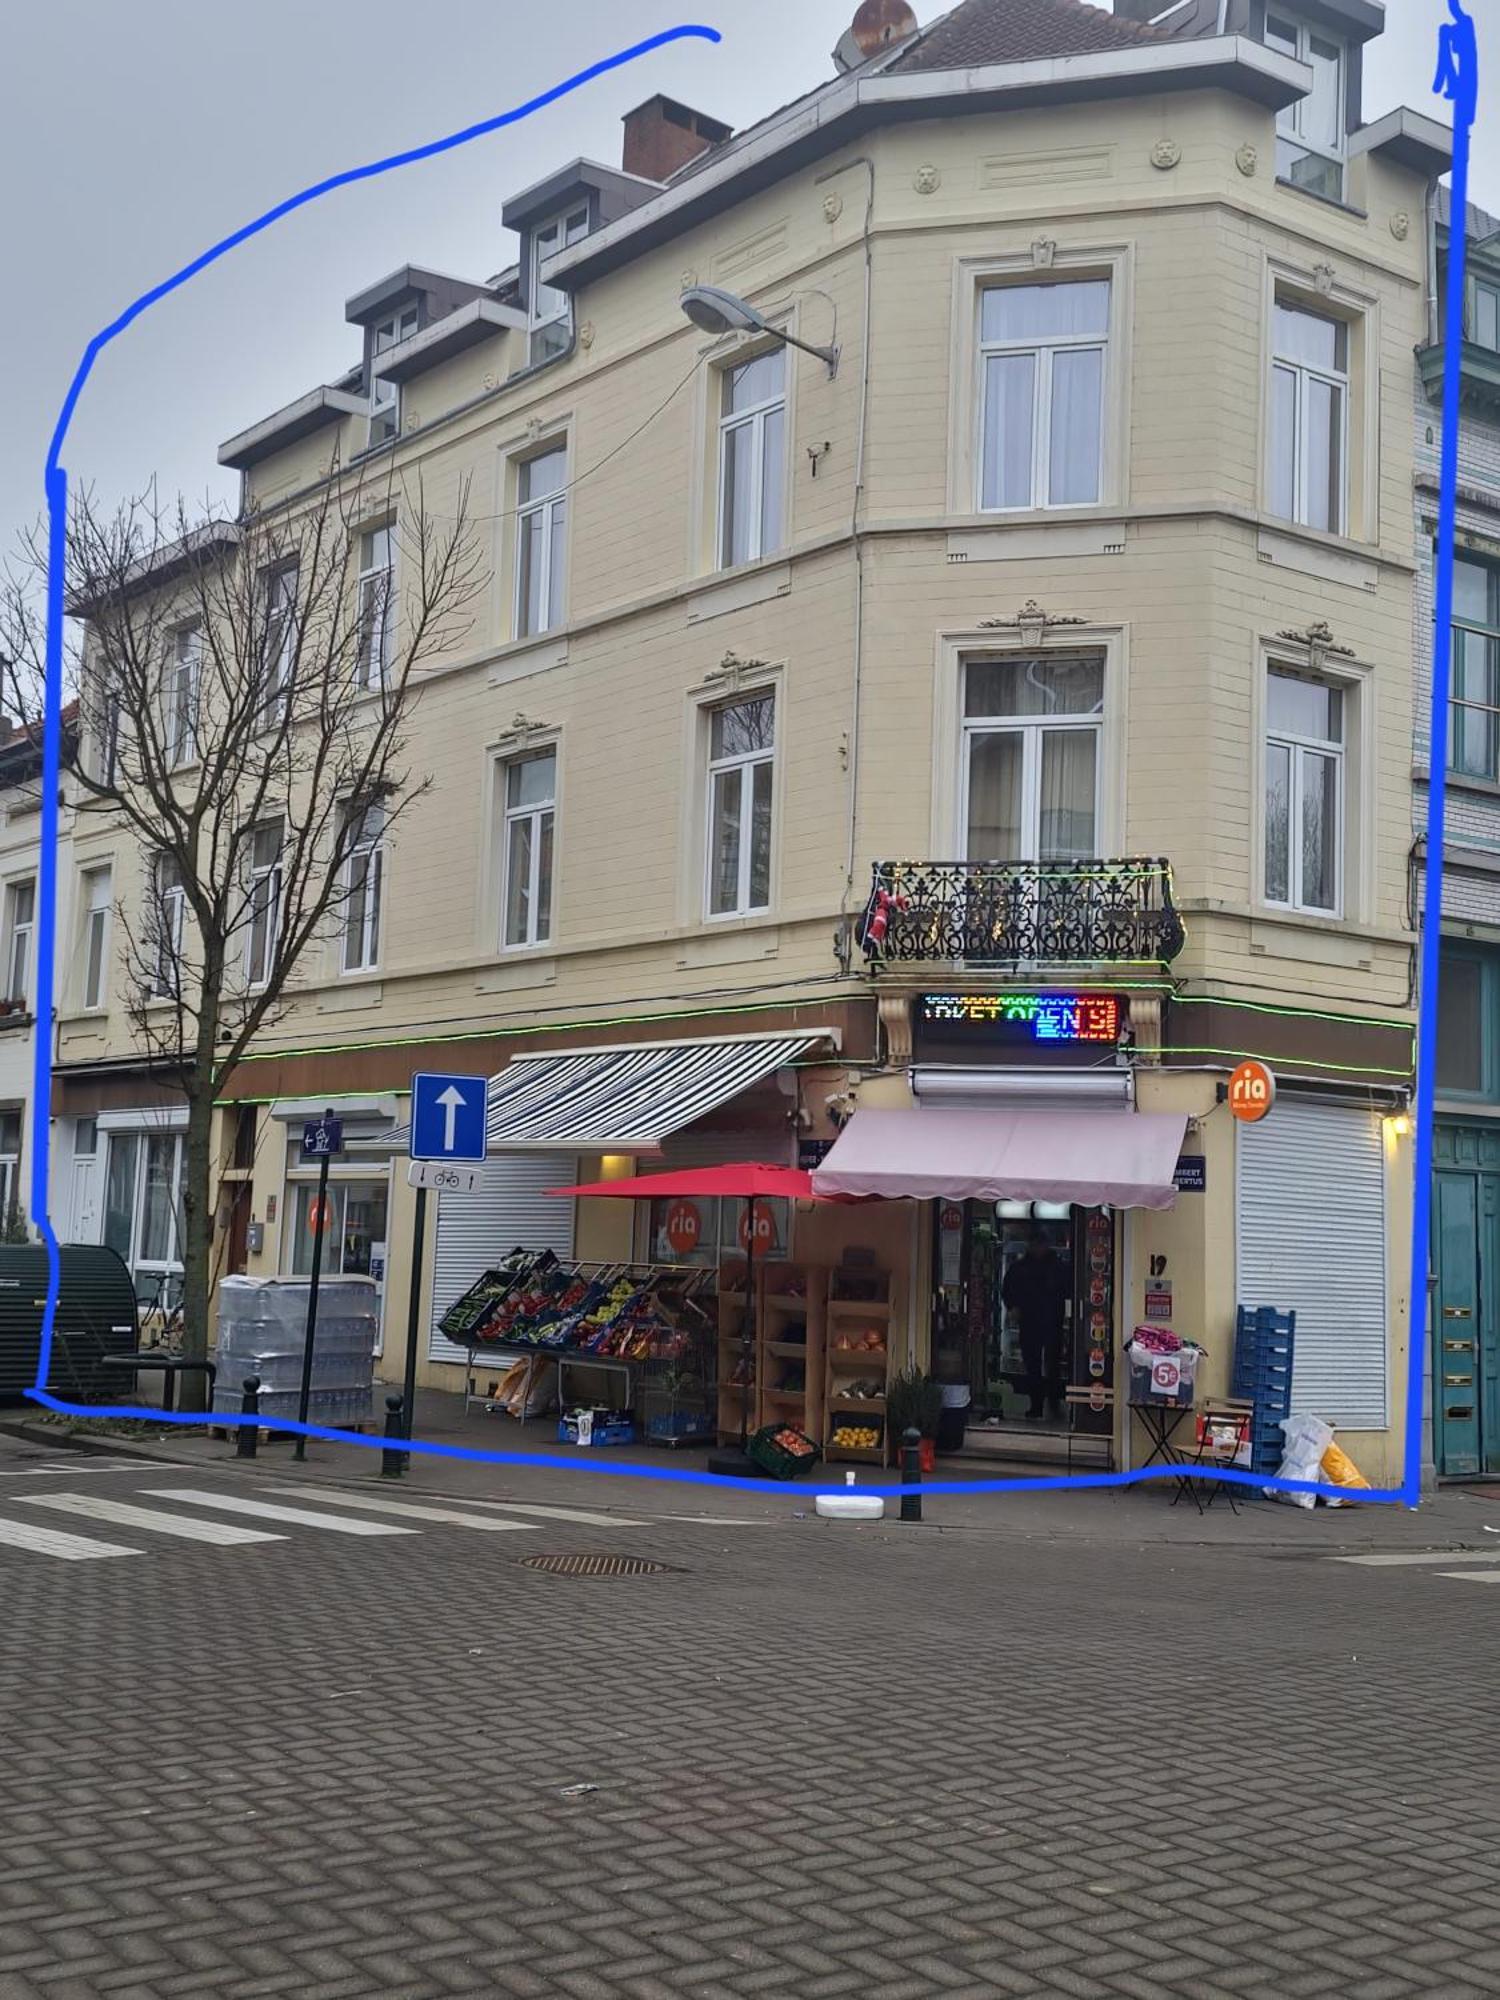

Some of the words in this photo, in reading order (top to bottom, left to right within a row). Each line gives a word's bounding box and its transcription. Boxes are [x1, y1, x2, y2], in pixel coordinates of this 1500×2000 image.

[1233, 1069, 1266, 1100] ria
[671, 1207, 696, 1233] ria
[1150, 1254, 1168, 1277] 19
[1158, 1366, 1177, 1384] 5€
